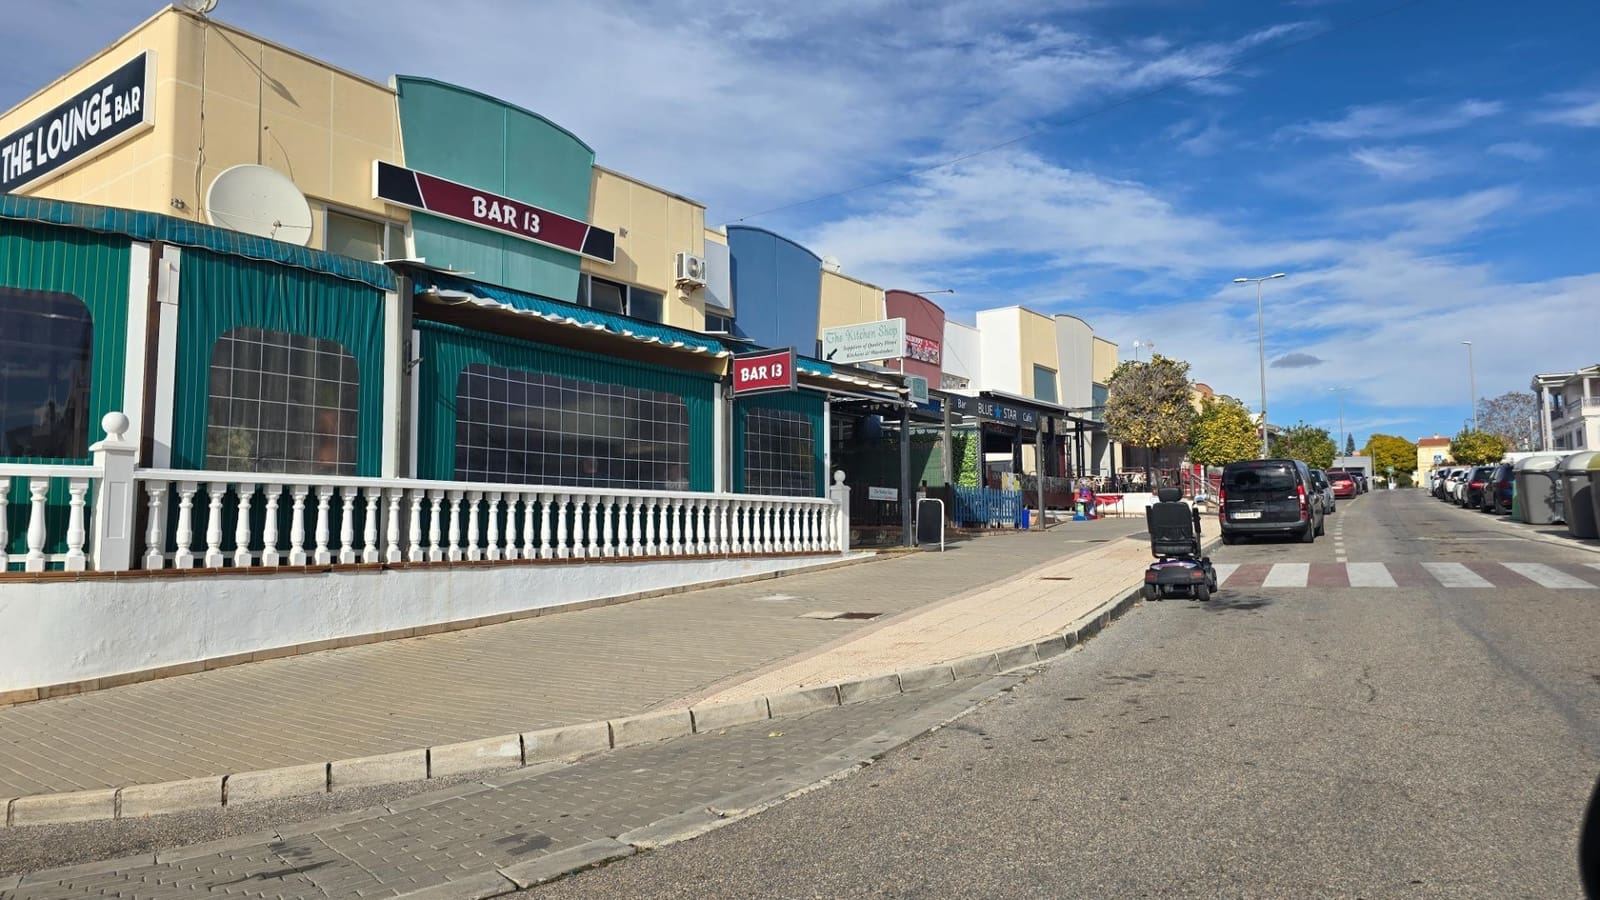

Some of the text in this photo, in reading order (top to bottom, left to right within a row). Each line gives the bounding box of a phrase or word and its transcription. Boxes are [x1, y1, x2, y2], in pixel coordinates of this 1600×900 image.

[1, 84, 141, 184] THE LOUNGE BAR
[472, 196, 540, 233] BAR 13
[825, 324, 898, 344] The Kitchen Shop
[741, 363, 783, 382] BAR 13
[957, 398, 967, 409] Bar
[977, 402, 993, 416] BLUE
[1003, 408, 1017, 421] STAR
